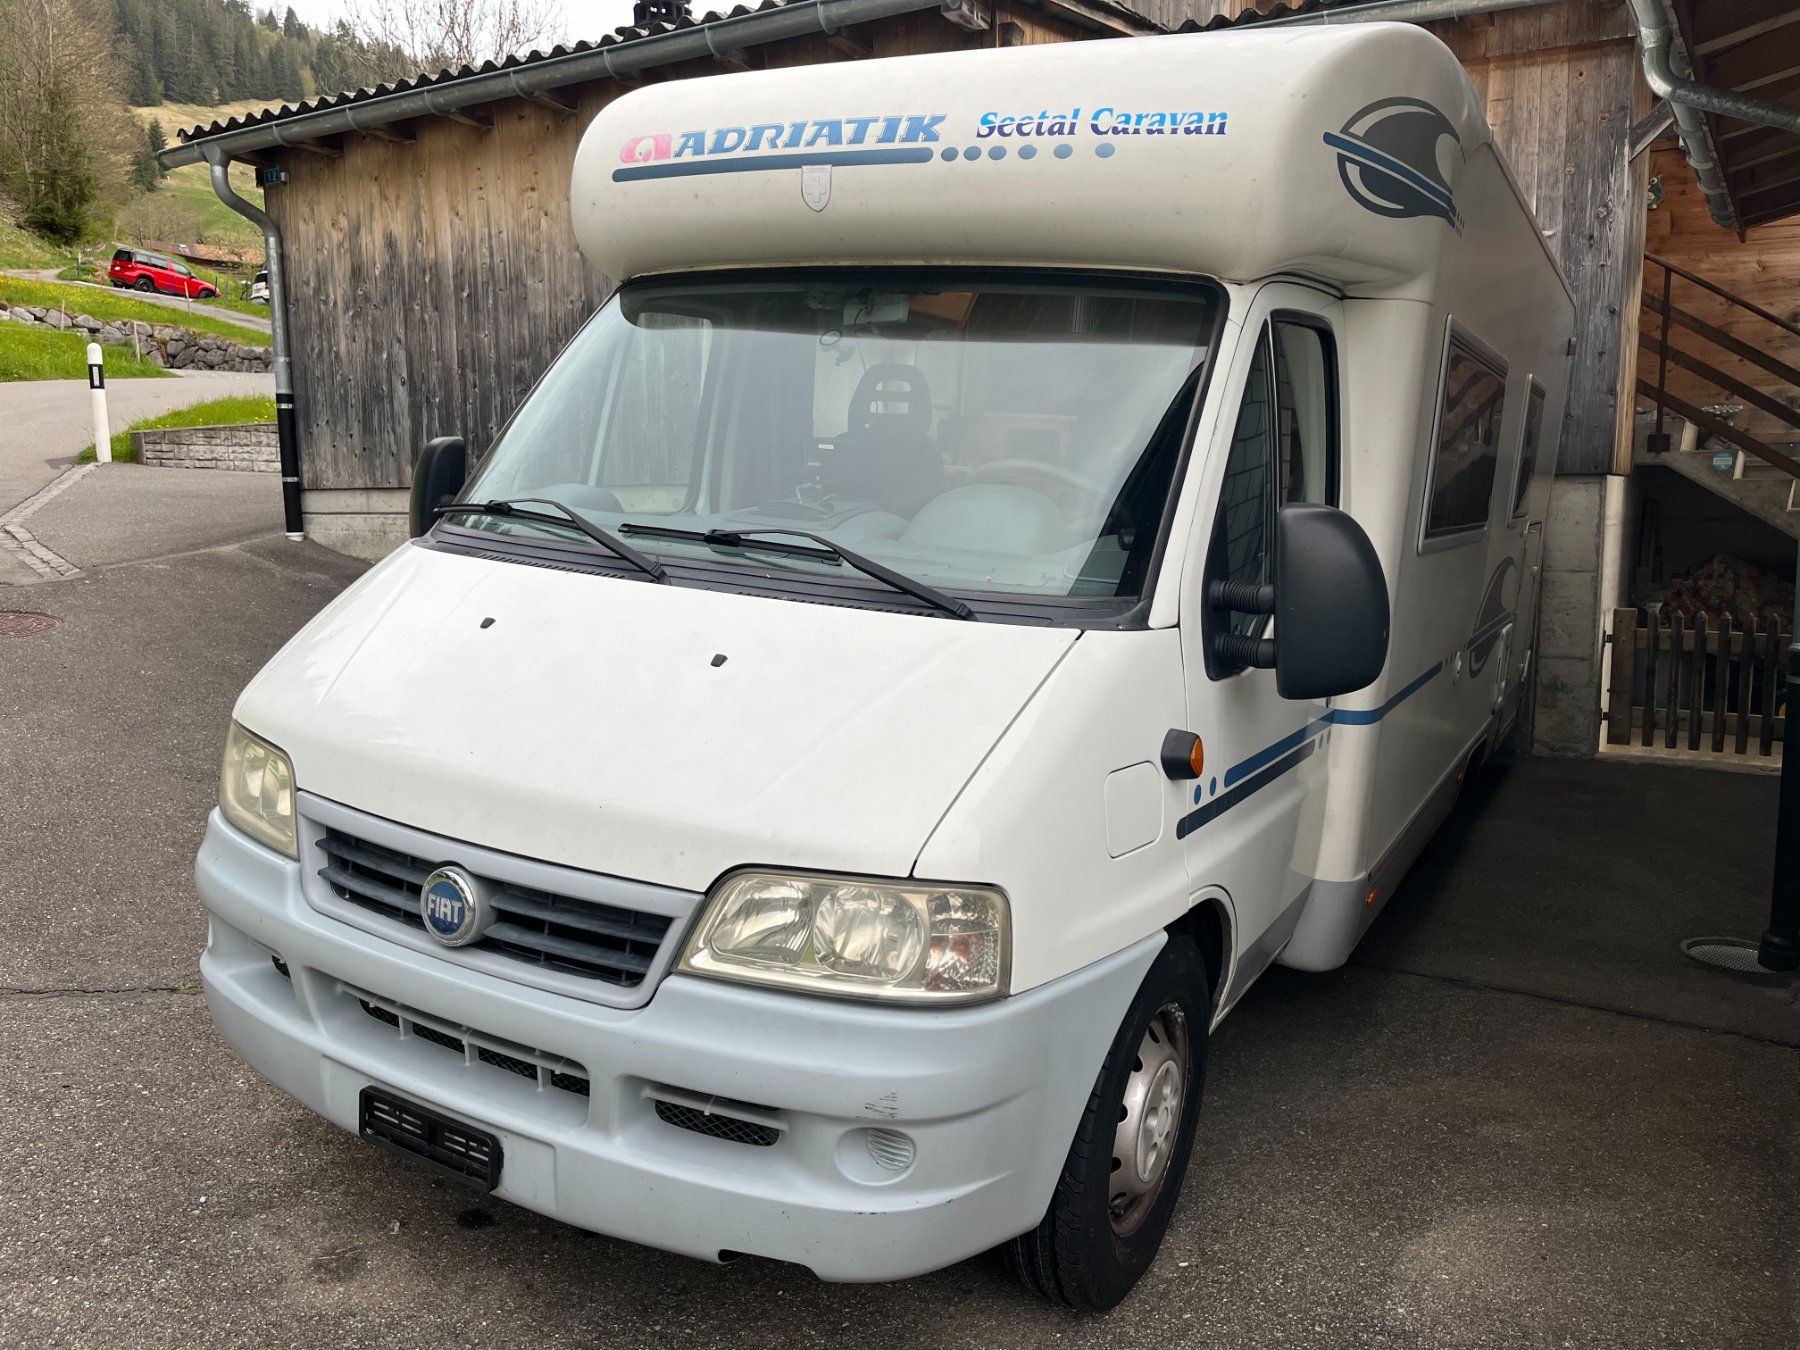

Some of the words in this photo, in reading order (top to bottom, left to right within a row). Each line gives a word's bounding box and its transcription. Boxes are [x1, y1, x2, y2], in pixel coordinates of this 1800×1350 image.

[673, 114, 947, 158] ADRIATIK
[976, 108, 1081, 138] Seetal
[1090, 107, 1228, 136] Caravan
[427, 892, 463, 924] FIAT
